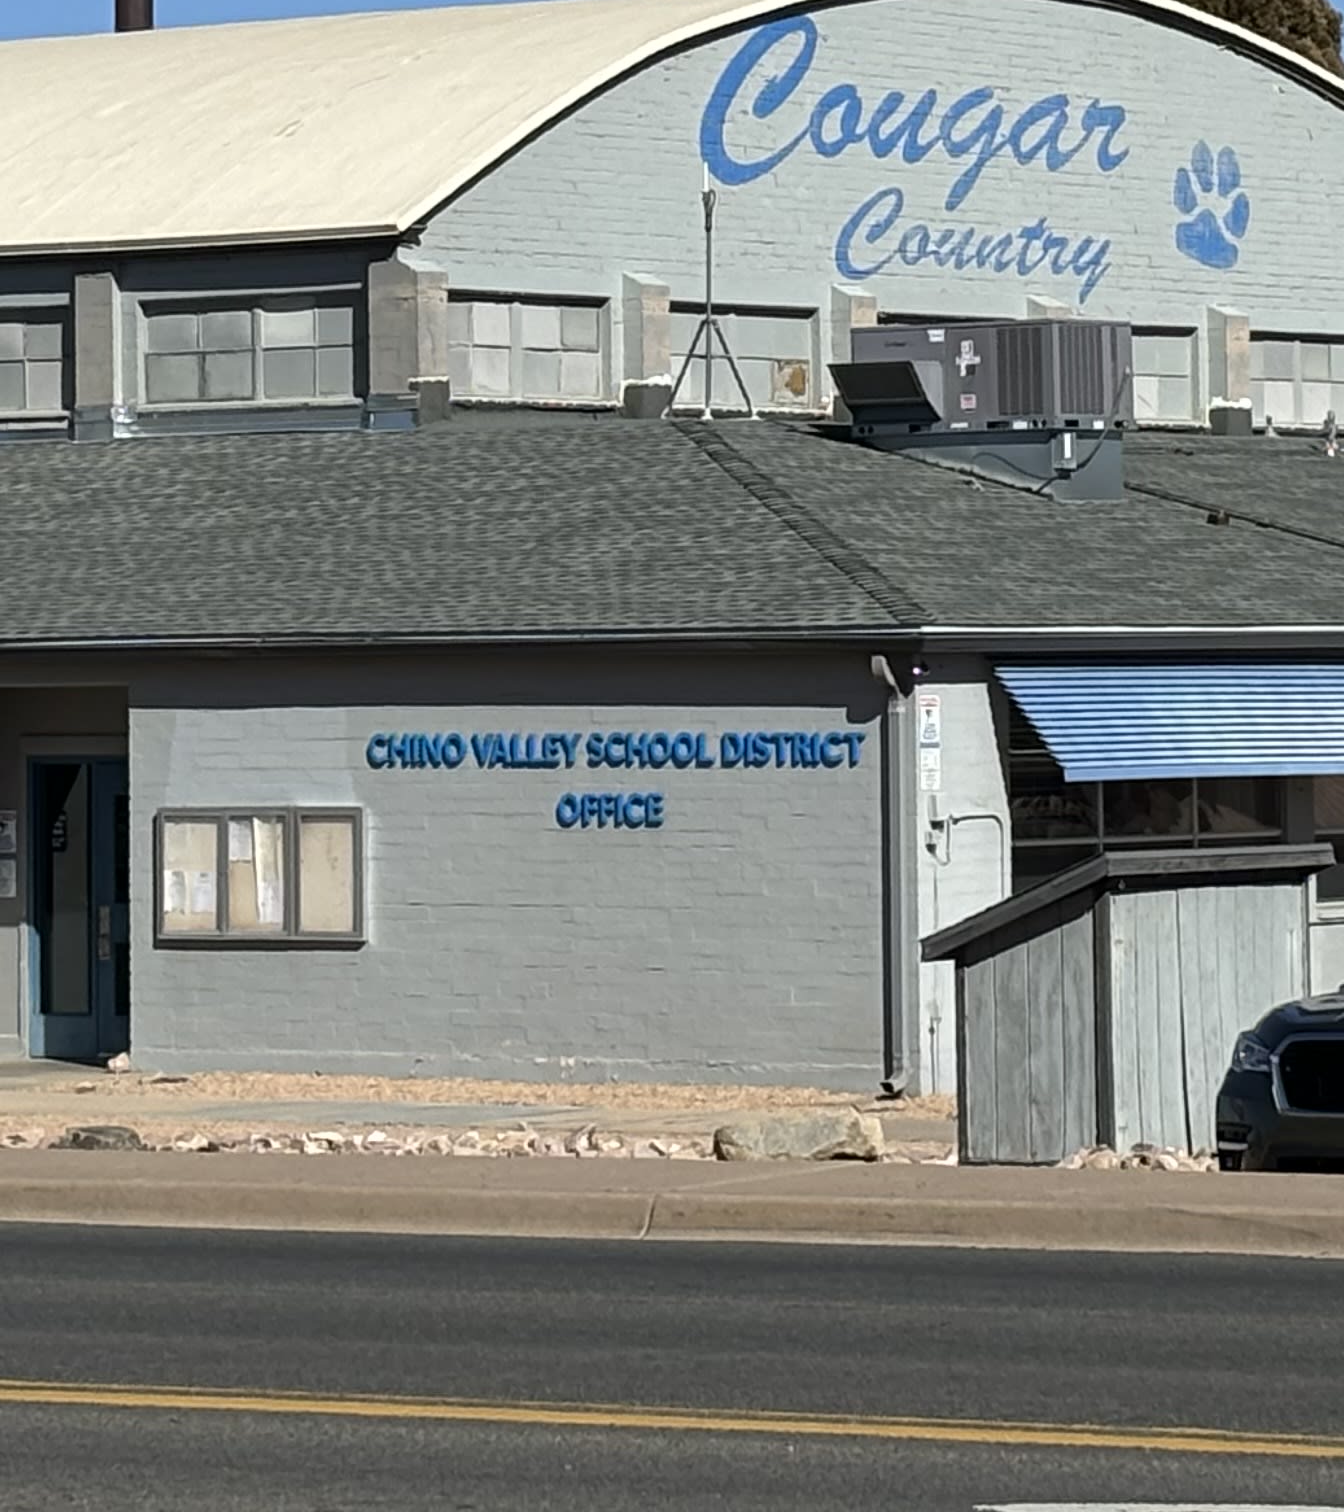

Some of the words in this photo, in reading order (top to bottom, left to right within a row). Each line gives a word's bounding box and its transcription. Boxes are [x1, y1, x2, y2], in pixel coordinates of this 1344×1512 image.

[699, 14, 1129, 210] Cougar
[835, 187, 1111, 304] Country
[366, 732, 467, 770] CHINO
[470, 732, 582, 770] VALLEY
[585, 731, 715, 769] SCHOOL
[719, 731, 866, 769] DISTRICT
[556, 792, 664, 829] OFFICE
